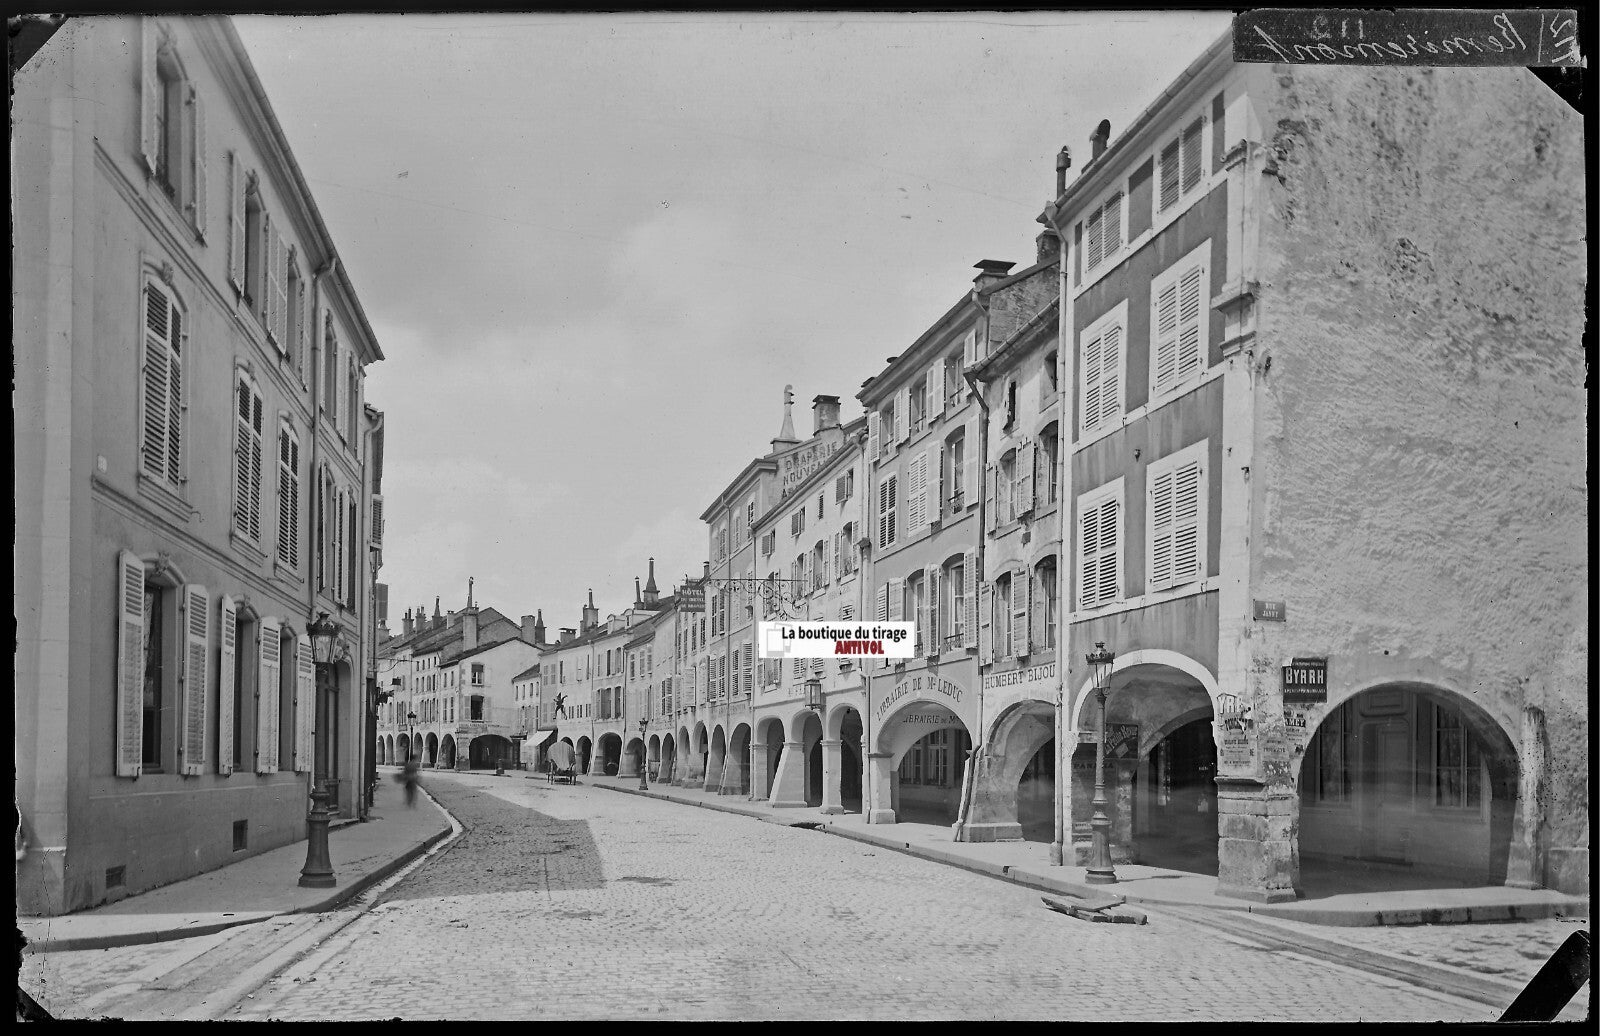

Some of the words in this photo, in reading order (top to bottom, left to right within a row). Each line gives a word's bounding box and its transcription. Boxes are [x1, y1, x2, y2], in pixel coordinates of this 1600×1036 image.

[985, 670, 1023, 690] HUMBERT
[1285, 667, 1324, 684] BYRRH
[876, 681, 908, 721] LIBRAIRIE
[912, 677, 922, 691] DE
[938, 679, 963, 703] LEDUC
